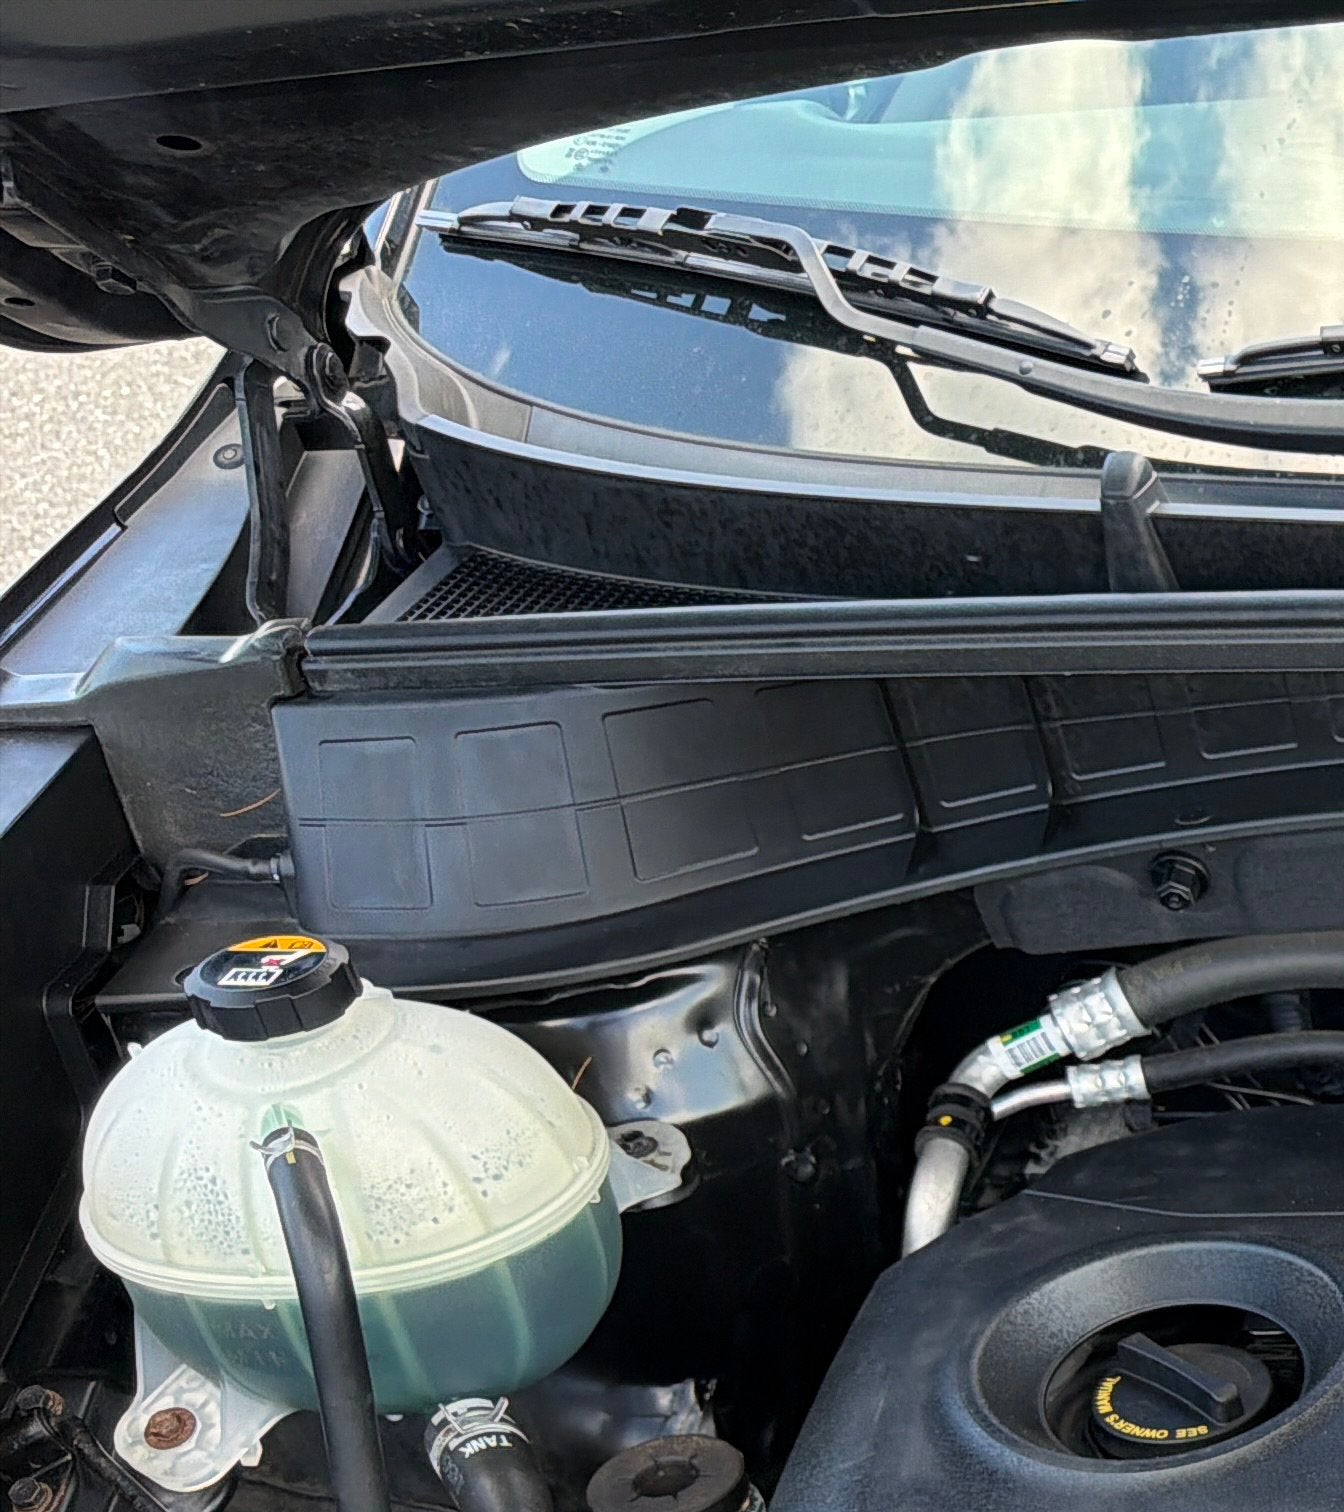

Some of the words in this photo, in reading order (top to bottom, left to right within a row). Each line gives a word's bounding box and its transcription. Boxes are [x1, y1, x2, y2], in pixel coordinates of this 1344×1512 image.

[1094, 1375, 1122, 1415] MANUAL
[1175, 1425, 1209, 1439] SEE
[458, 1434, 513, 1459] TANK
